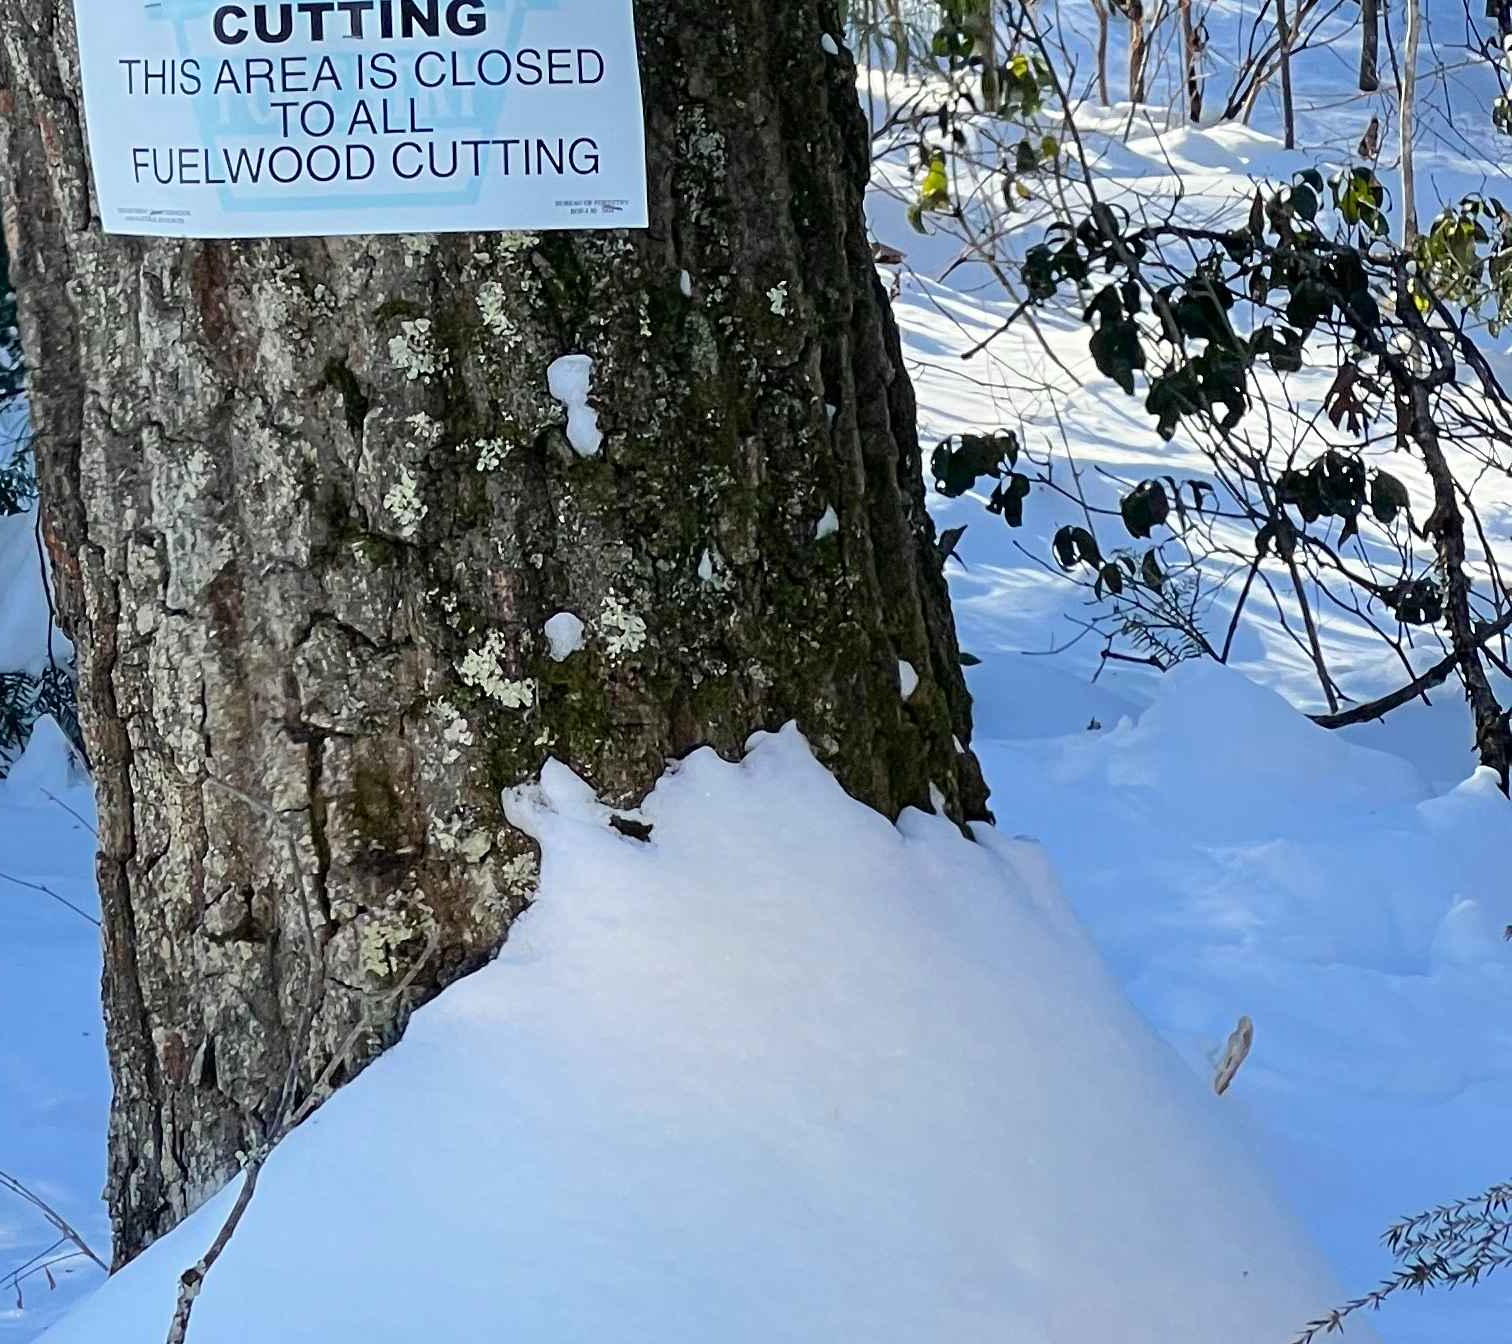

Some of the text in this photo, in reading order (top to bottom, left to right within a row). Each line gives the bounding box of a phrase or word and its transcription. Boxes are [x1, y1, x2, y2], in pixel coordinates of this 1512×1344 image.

[119, 59, 201, 95] THIS
[213, 55, 342, 94] AREA
[357, 54, 397, 91] IS
[414, 49, 605, 88] CLOSED
[270, 98, 434, 138] TO ALL
[132, 137, 600, 185] FUELWOOD CUTTING
